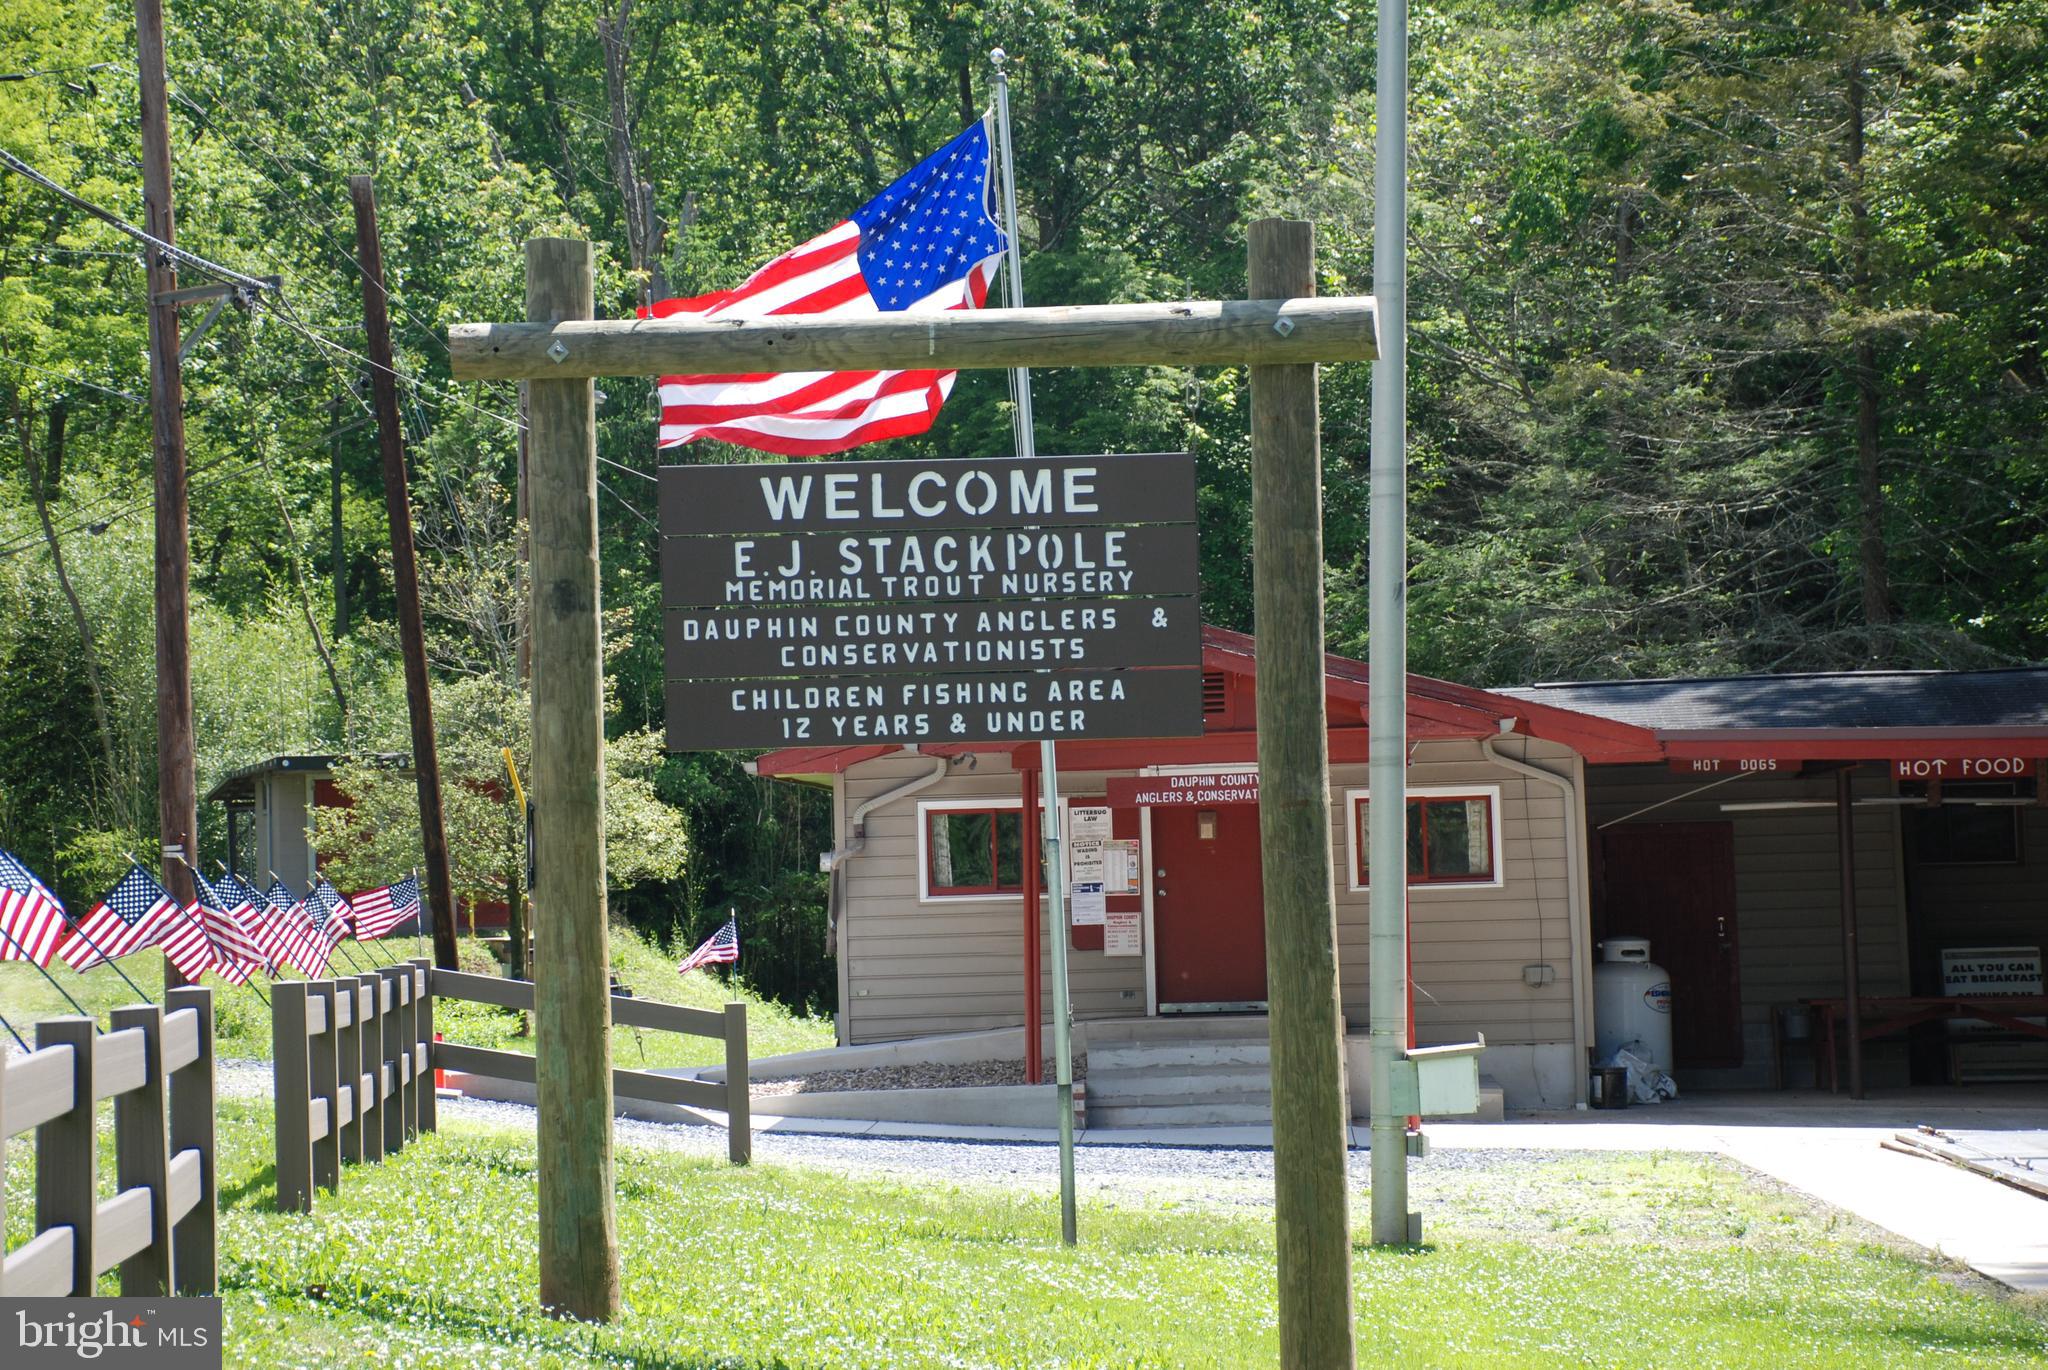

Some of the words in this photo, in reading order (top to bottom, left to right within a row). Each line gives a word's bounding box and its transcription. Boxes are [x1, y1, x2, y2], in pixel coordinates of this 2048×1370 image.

[760, 468, 1098, 520] WELCOME
[838, 531, 1131, 577] STACKPOLE
[725, 577, 871, 602] MEMORIAL
[881, 574, 984, 598] TROUT
[1001, 570, 1134, 594] NURSERY
[683, 616, 817, 641] DAUPHIN
[835, 612, 958, 637] COUNTY
[976, 608, 1117, 633] ANGLERS
[1151, 607, 1168, 628] &
[781, 638, 1085, 667] CONSERVATIONISTS
[731, 686, 884, 712] CHILDREN
[902, 681, 1027, 706] FISHING
[1048, 679, 1126, 702] AREA
[782, 717, 811, 739] 12
[831, 713, 930, 737] YEARS
[949, 712, 967, 734] &
[987, 709, 1085, 733] UNDER
[1693, 759, 1720, 771] HOT
[1740, 758, 1776, 771] DOGS
[1900, 759, 1947, 776] HOT
[1962, 757, 2024, 775] FOOD
[1170, 776, 1215, 788] DAUPHIN
[1220, 774, 1259, 786] COUNTY
[1135, 791, 1183, 804] ANGLERS
[1185, 791, 1194, 802] &
[1945, 975, 1968, 984] EAT
[1970, 974, 2043, 984] BREAKFAST
[1951, 964, 1975, 973] ALL
[1976, 963, 2004, 972] YOU
[2007, 963, 2034, 972] CAN
